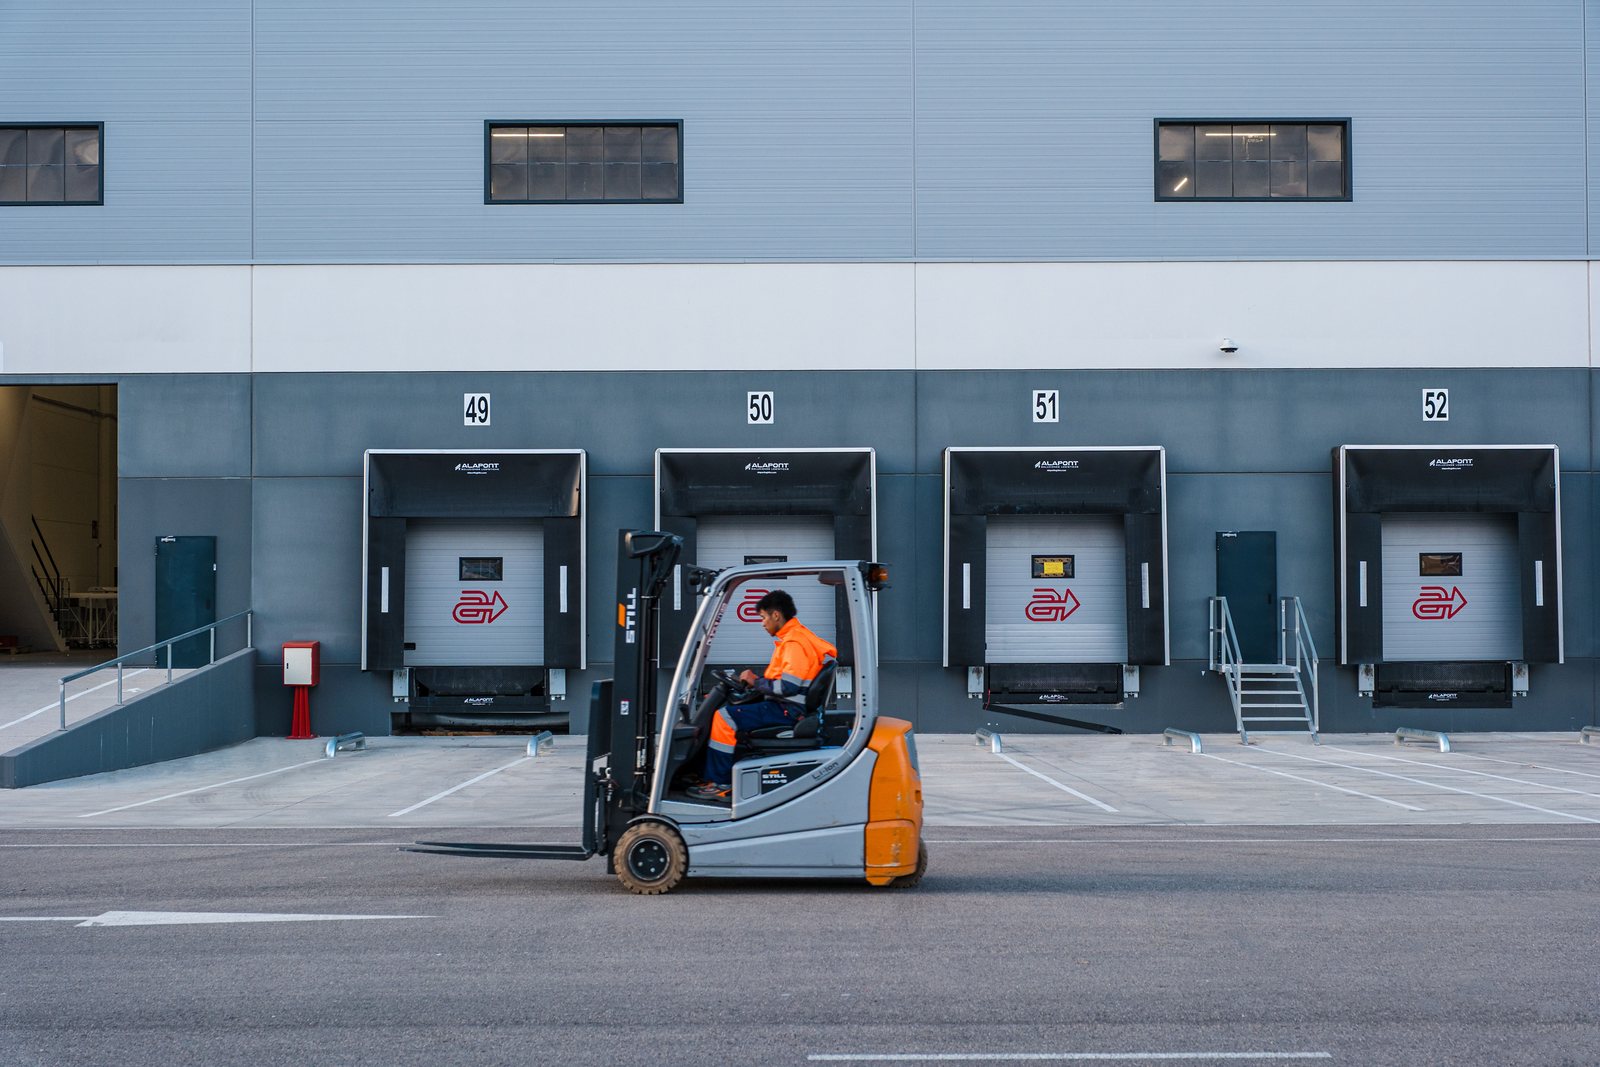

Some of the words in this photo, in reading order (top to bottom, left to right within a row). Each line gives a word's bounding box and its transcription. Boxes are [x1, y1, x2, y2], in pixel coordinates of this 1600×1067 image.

[465, 396, 489, 423] 49
[750, 394, 772, 421] 50
[1036, 392, 1056, 420] 51
[1425, 391, 1447, 419] 52
[625, 587, 637, 643] STILL
